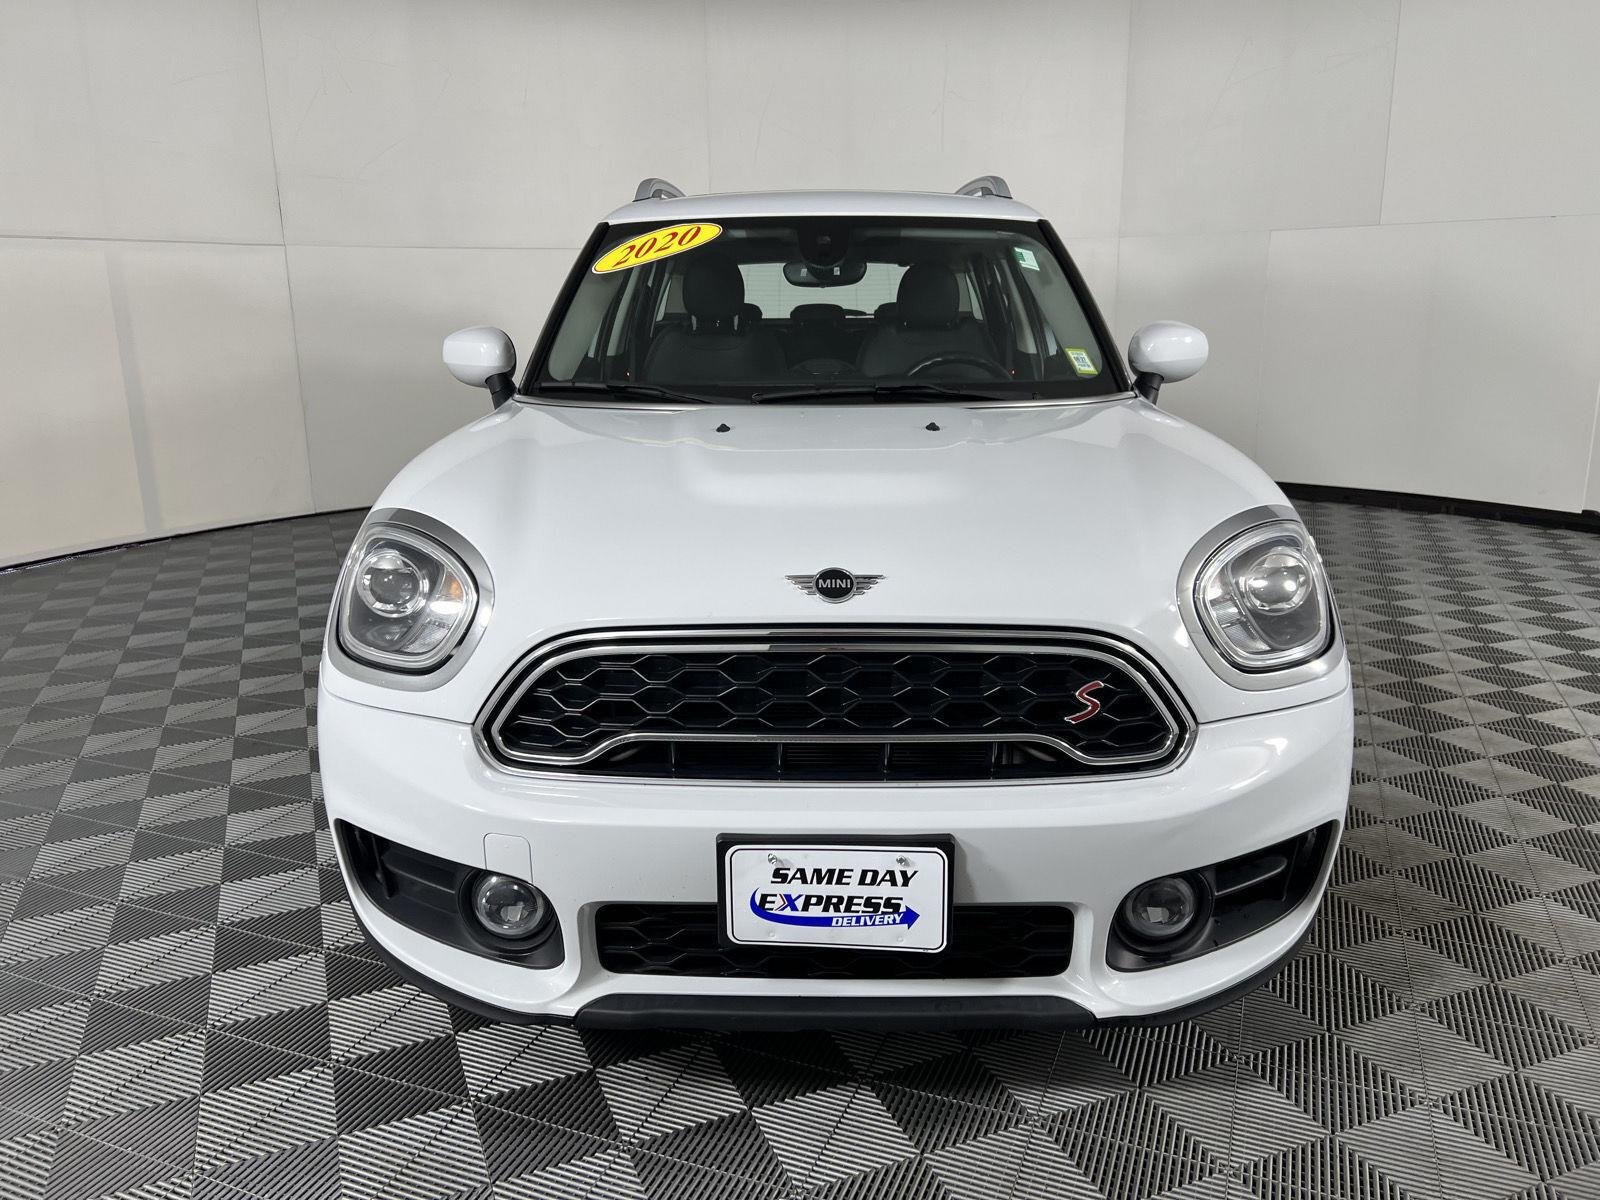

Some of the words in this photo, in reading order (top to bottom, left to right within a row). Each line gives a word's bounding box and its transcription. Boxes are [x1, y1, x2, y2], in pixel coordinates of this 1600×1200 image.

[612, 226, 701, 267] 2020
[818, 578, 851, 588] MINI
[1064, 680, 1104, 724] S
[771, 867, 853, 886] SAME
[858, 869, 918, 887] DAY
[758, 893, 903, 914] EXPRESS
[831, 914, 904, 927] DELIVERY
